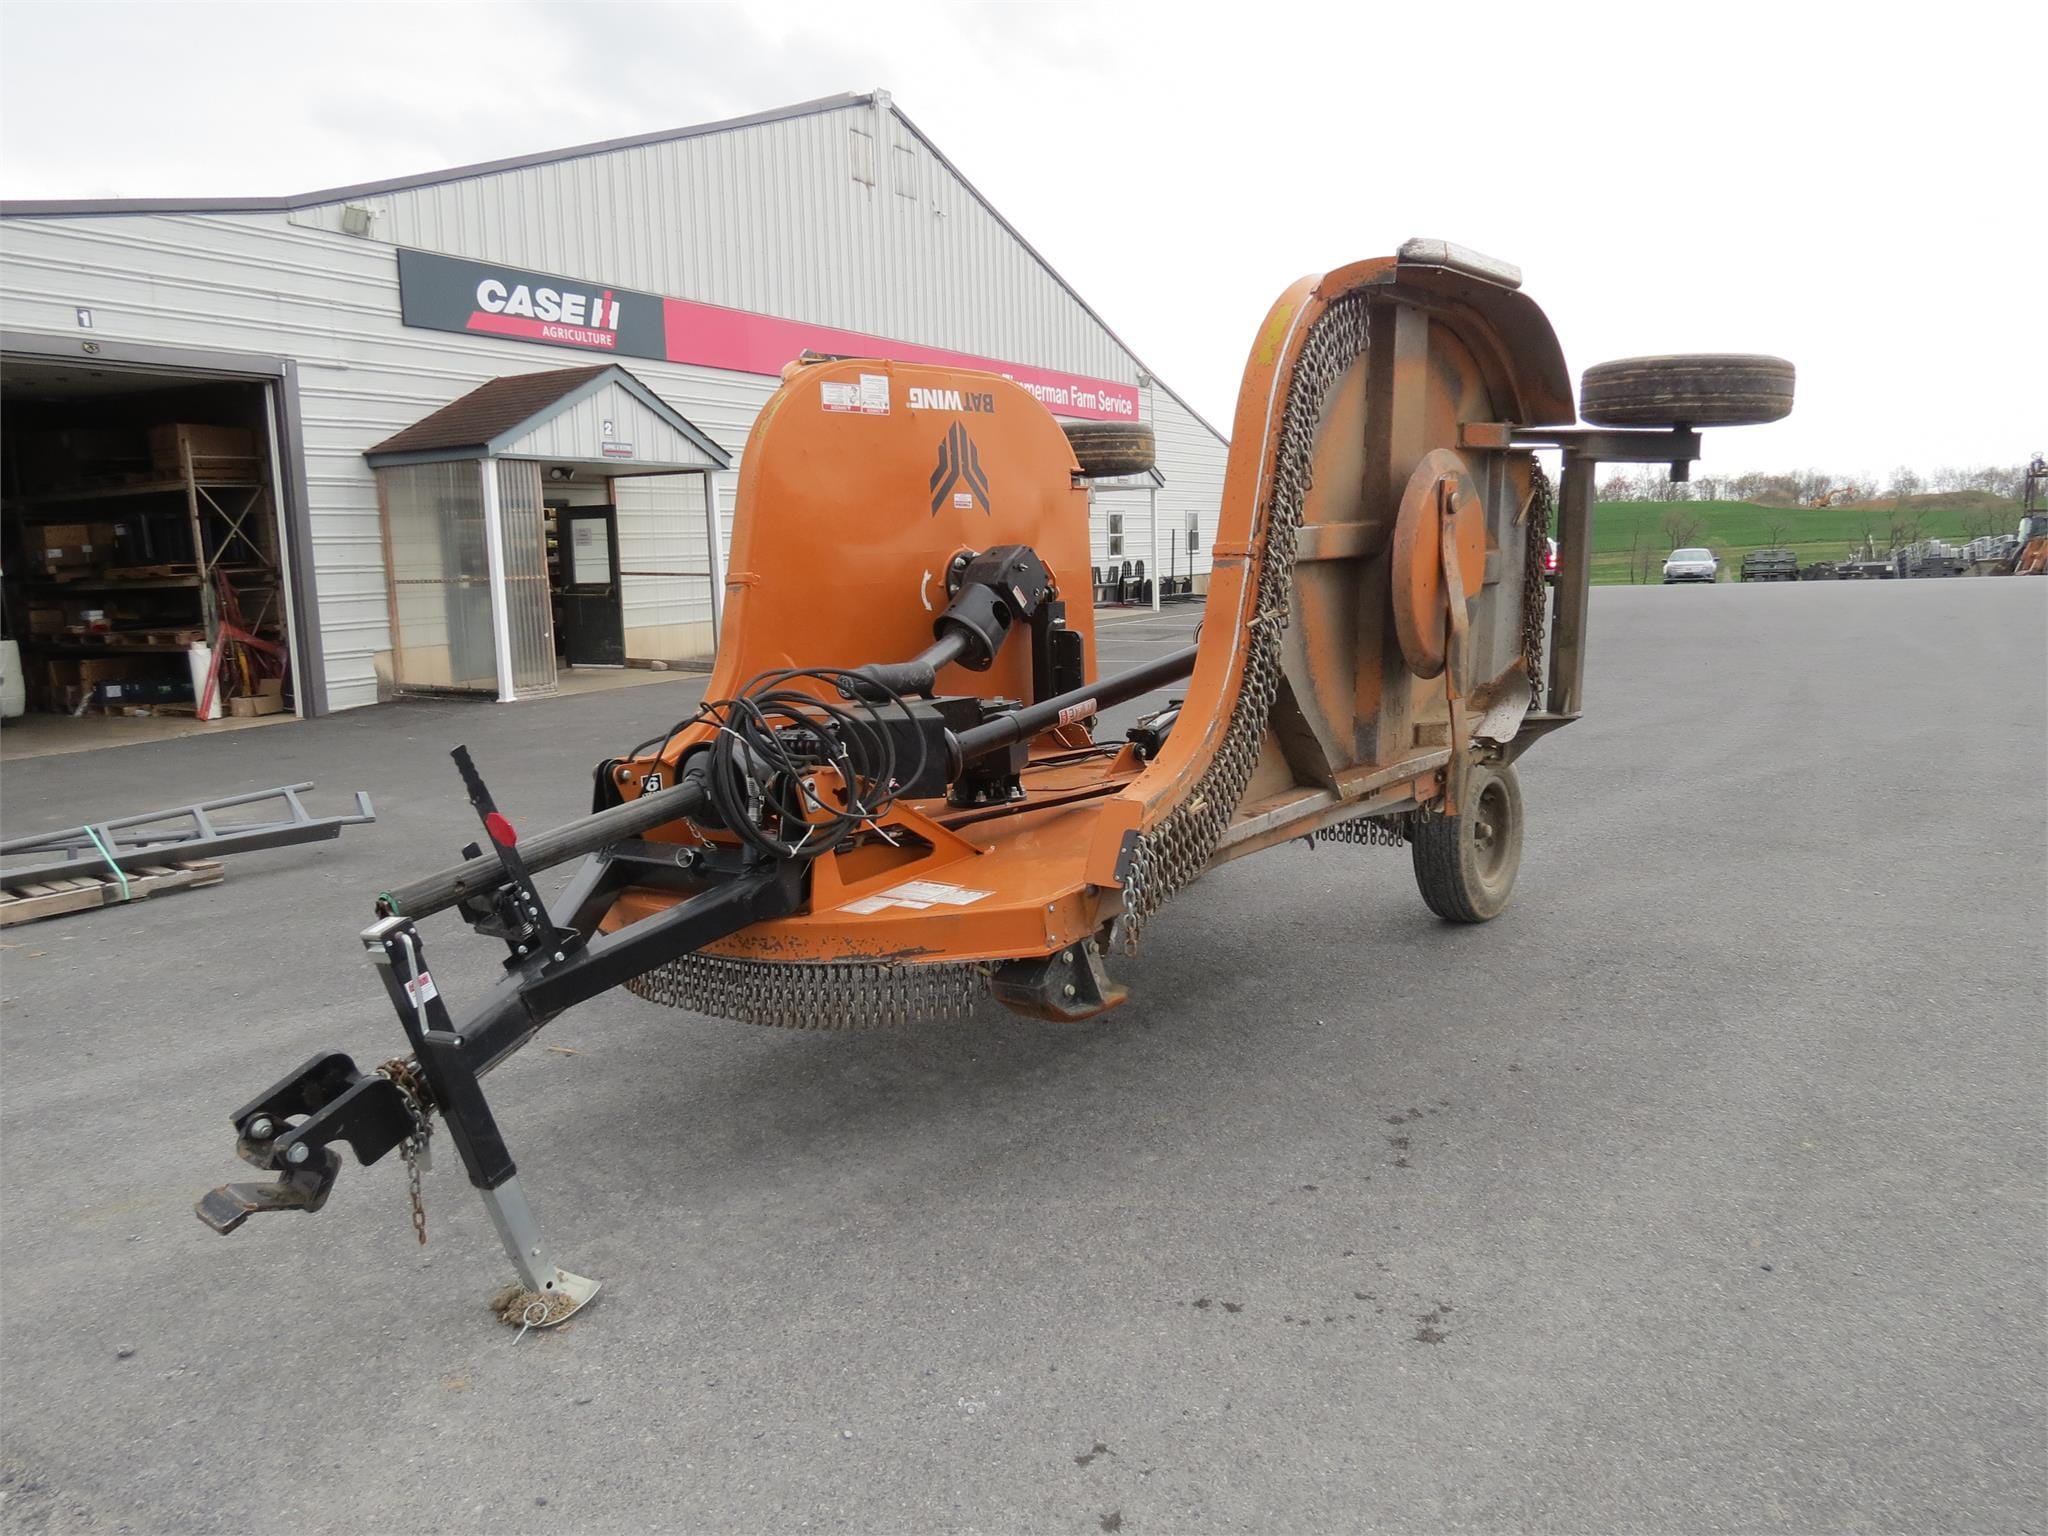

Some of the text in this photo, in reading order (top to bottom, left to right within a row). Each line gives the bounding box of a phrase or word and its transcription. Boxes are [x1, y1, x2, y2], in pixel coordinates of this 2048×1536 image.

[477, 279, 586, 326] CASE
[79, 311, 90, 327] 1
[542, 325, 612, 346] AGRICULTURE
[1071, 385, 1097, 410] Farm
[1098, 390, 1133, 415] Service
[604, 422, 612, 435] 2
[645, 776, 660, 792] 6
